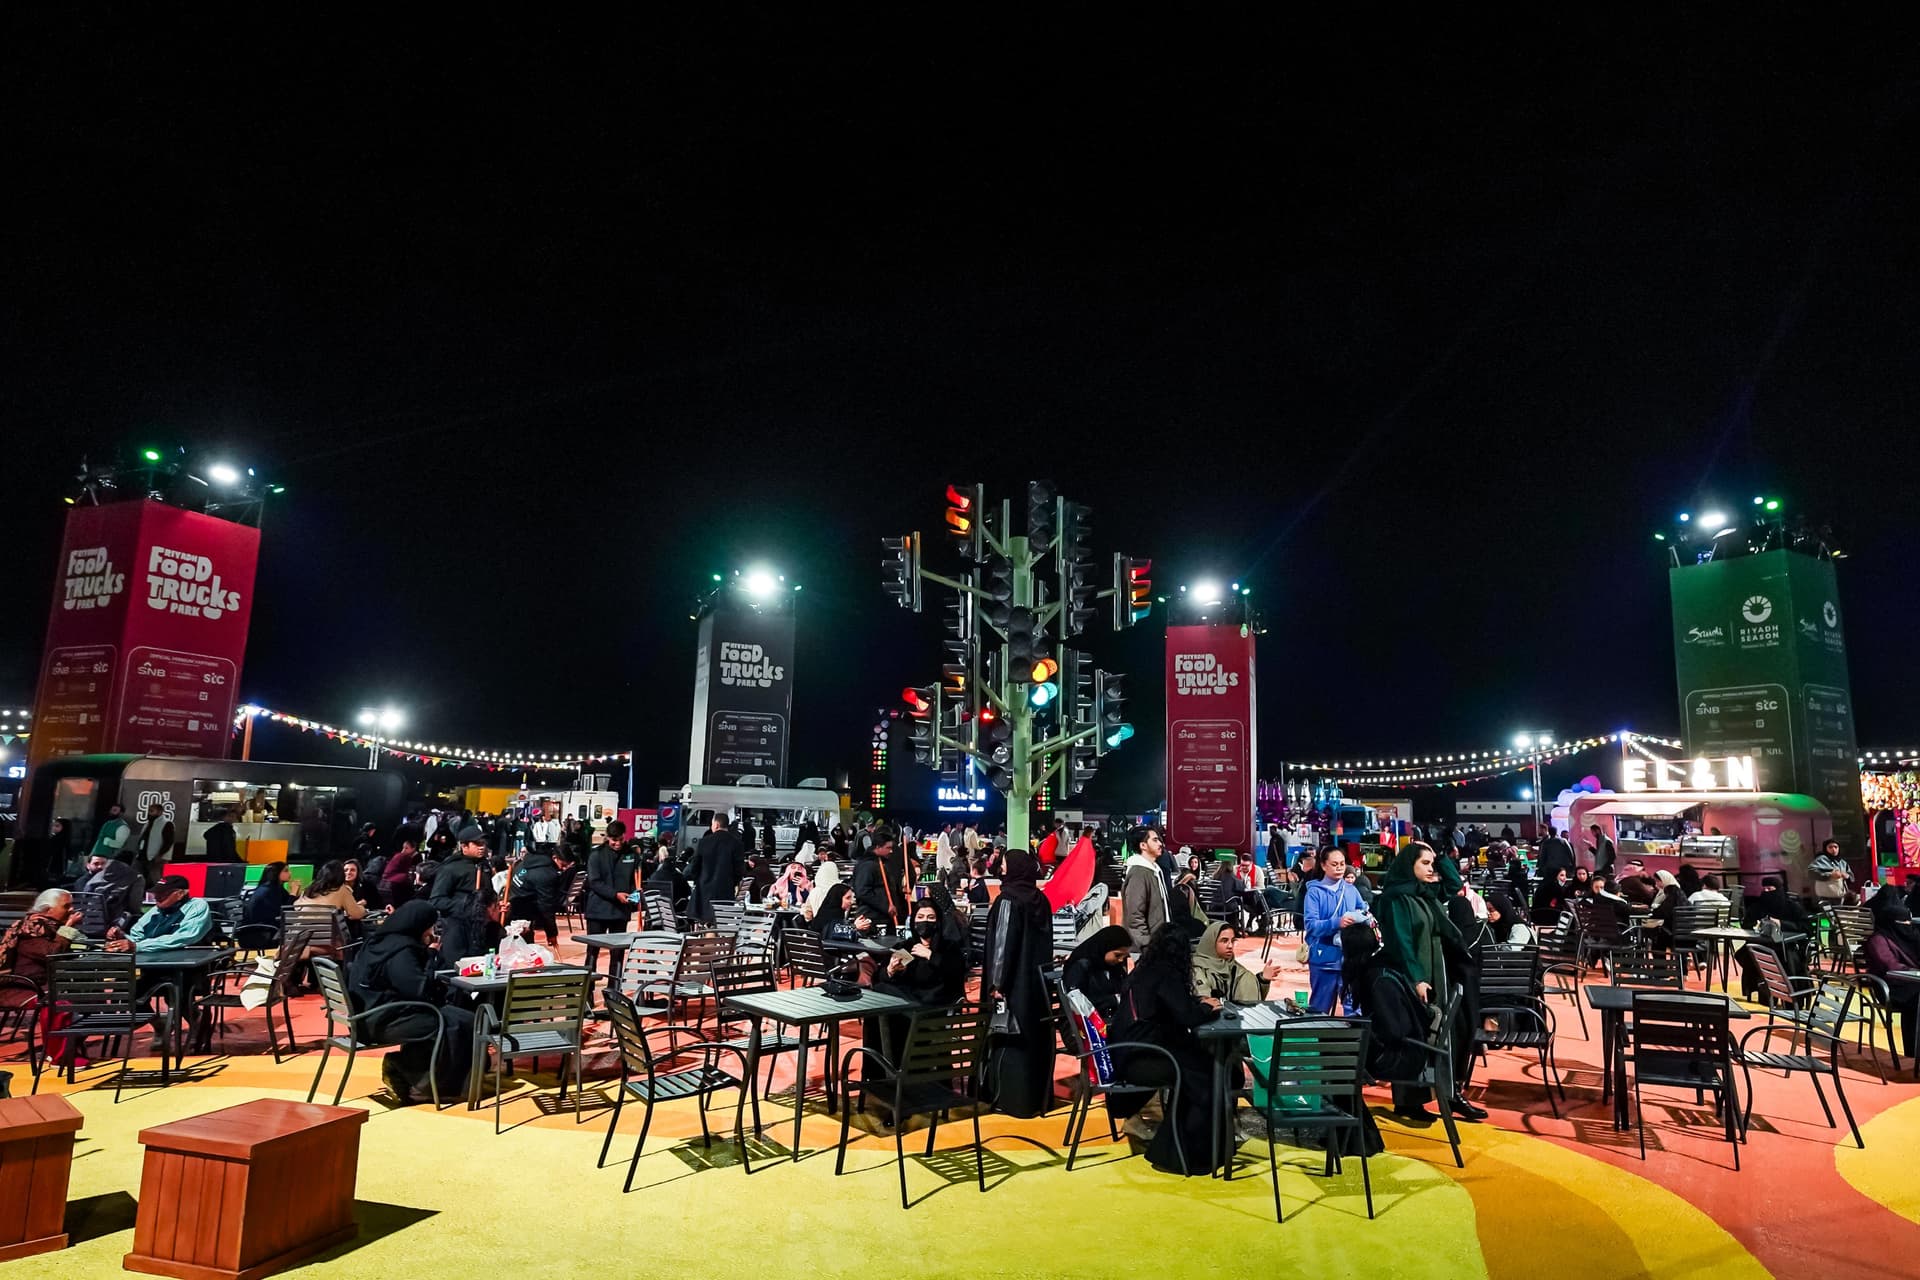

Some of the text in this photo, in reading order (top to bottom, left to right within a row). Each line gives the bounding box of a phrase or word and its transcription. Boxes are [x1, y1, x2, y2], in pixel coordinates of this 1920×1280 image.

[169, 602, 201, 616] PARK
[1740, 625, 1779, 636] RIYADH
[1740, 632, 1780, 643] SEASON
[136, 665, 167, 678] SNB
[1695, 706, 1720, 716] SNB
